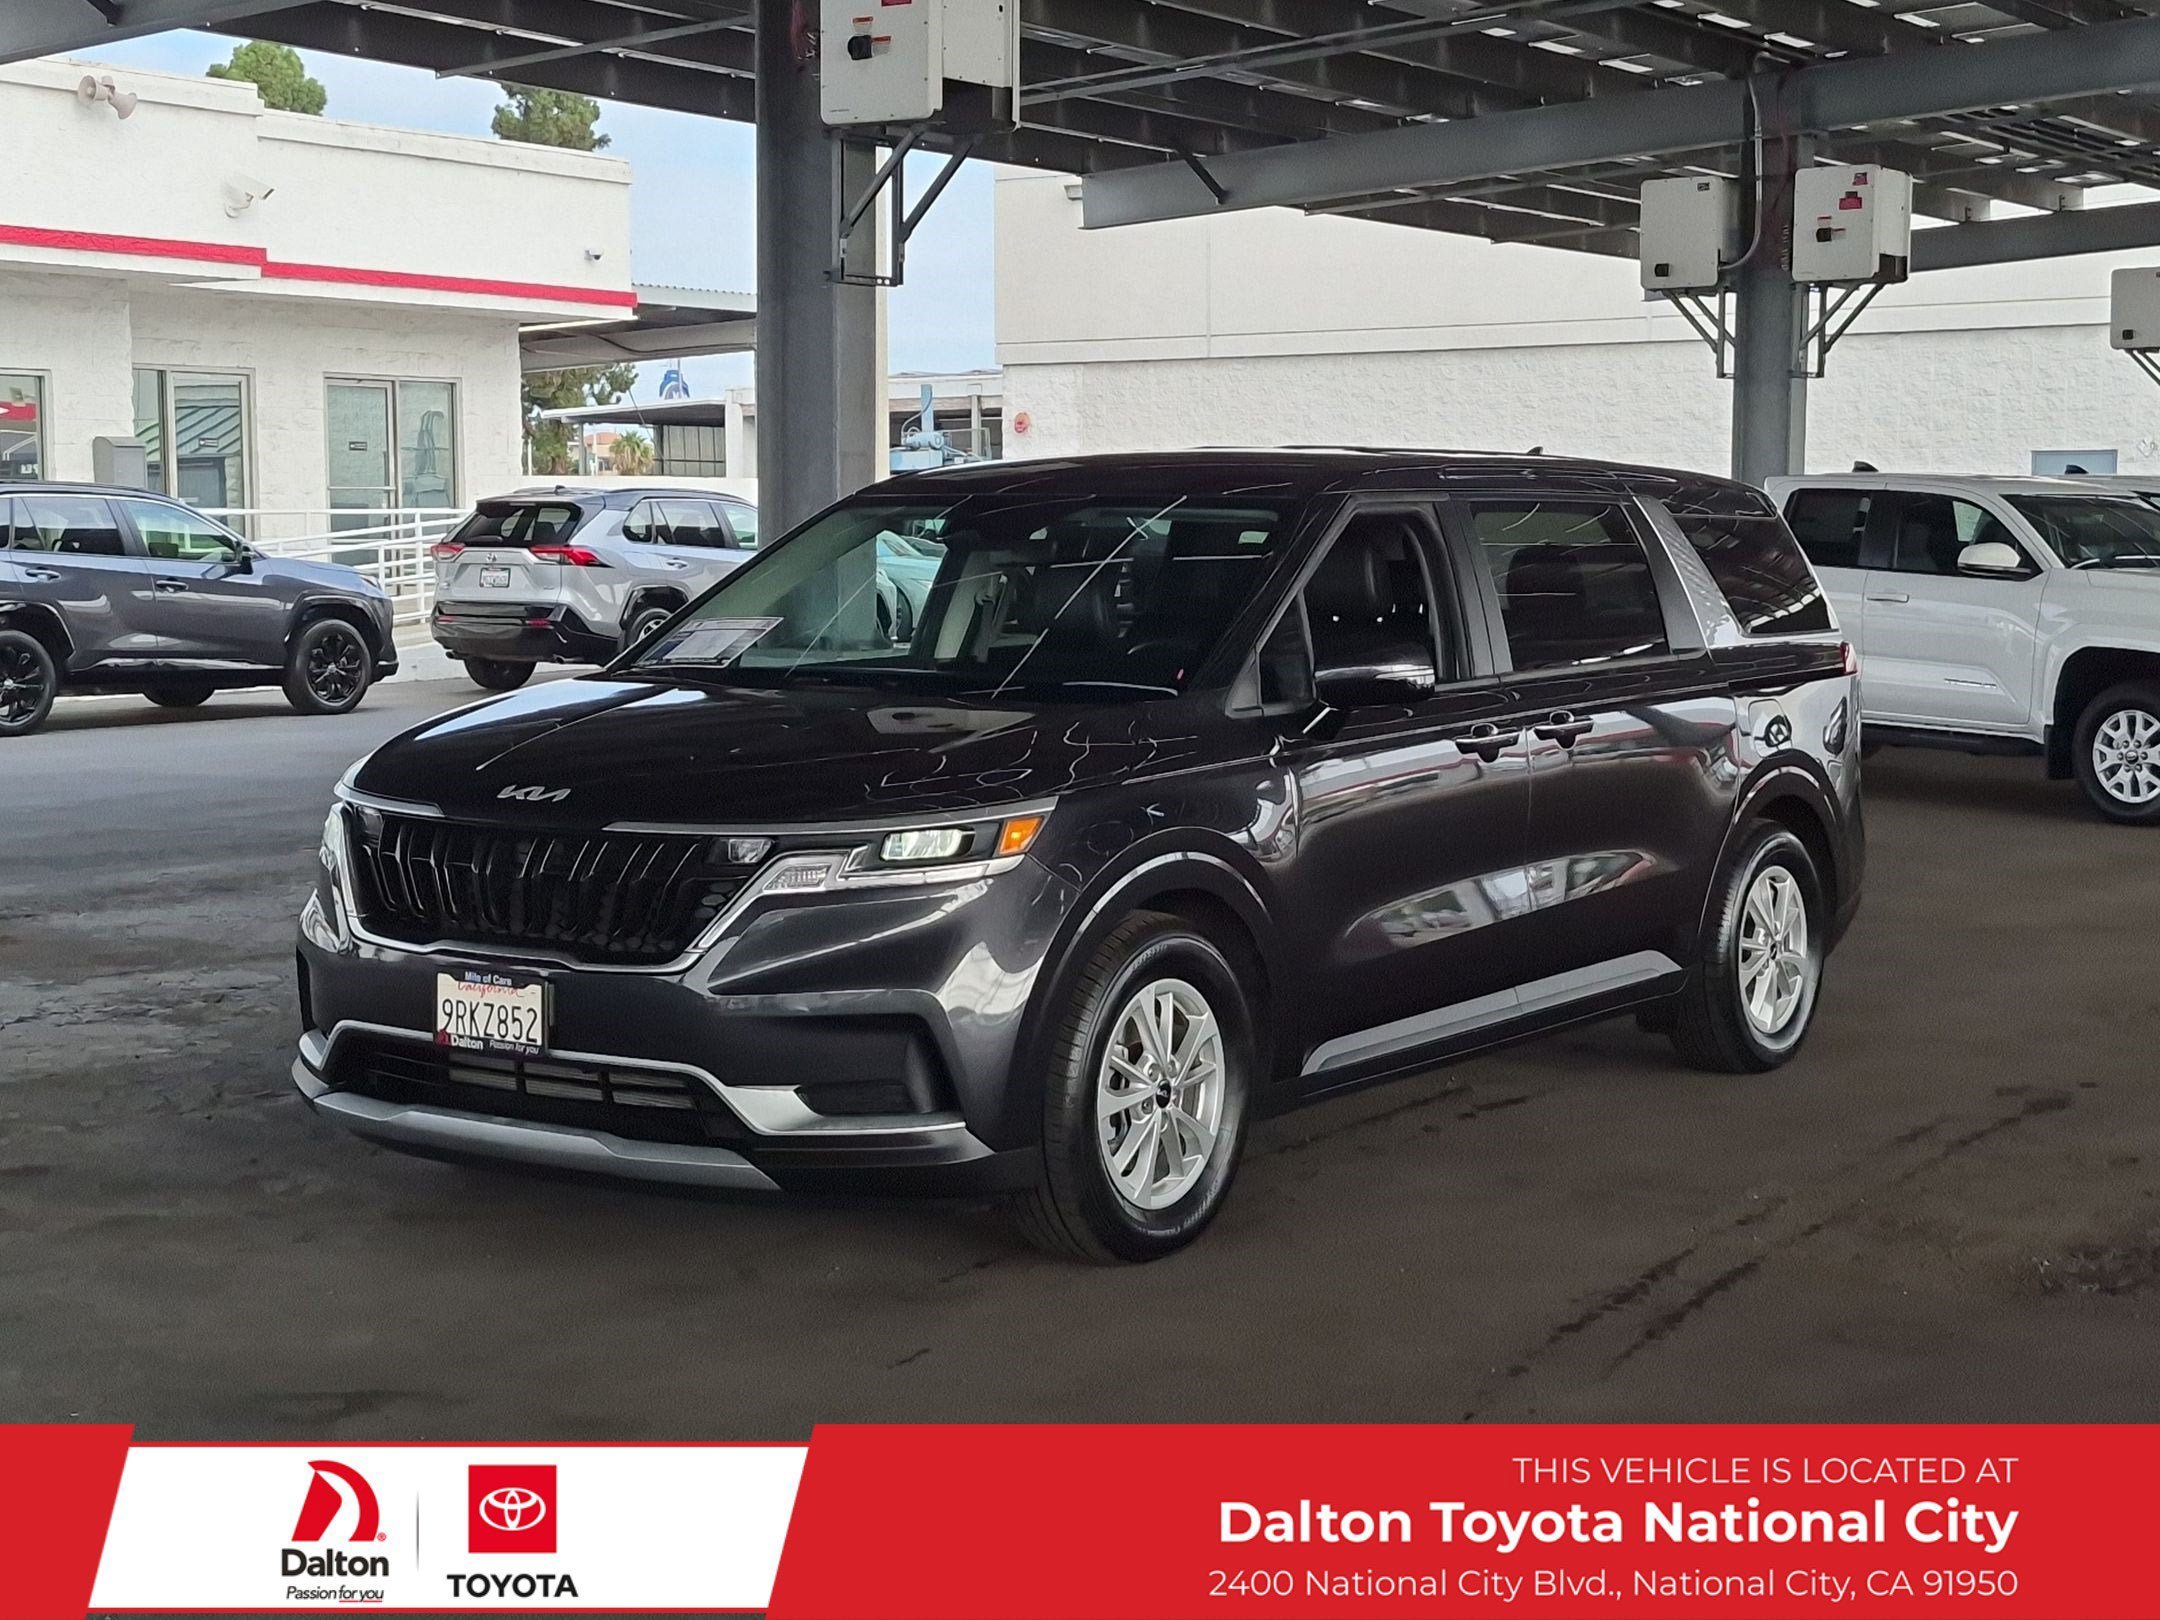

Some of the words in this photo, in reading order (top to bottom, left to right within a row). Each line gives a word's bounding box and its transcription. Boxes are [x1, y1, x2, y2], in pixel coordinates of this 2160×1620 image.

[464, 971, 481, 983] Mile
[483, 973, 491, 983] of
[493, 974, 512, 986] Cars
[442, 998, 538, 1043] 9RKZ852
[451, 1035, 484, 1050] Dalton
[489, 1040, 514, 1050] Passion
[515, 1042, 525, 1053] for
[525, 1046, 539, 1055] you
